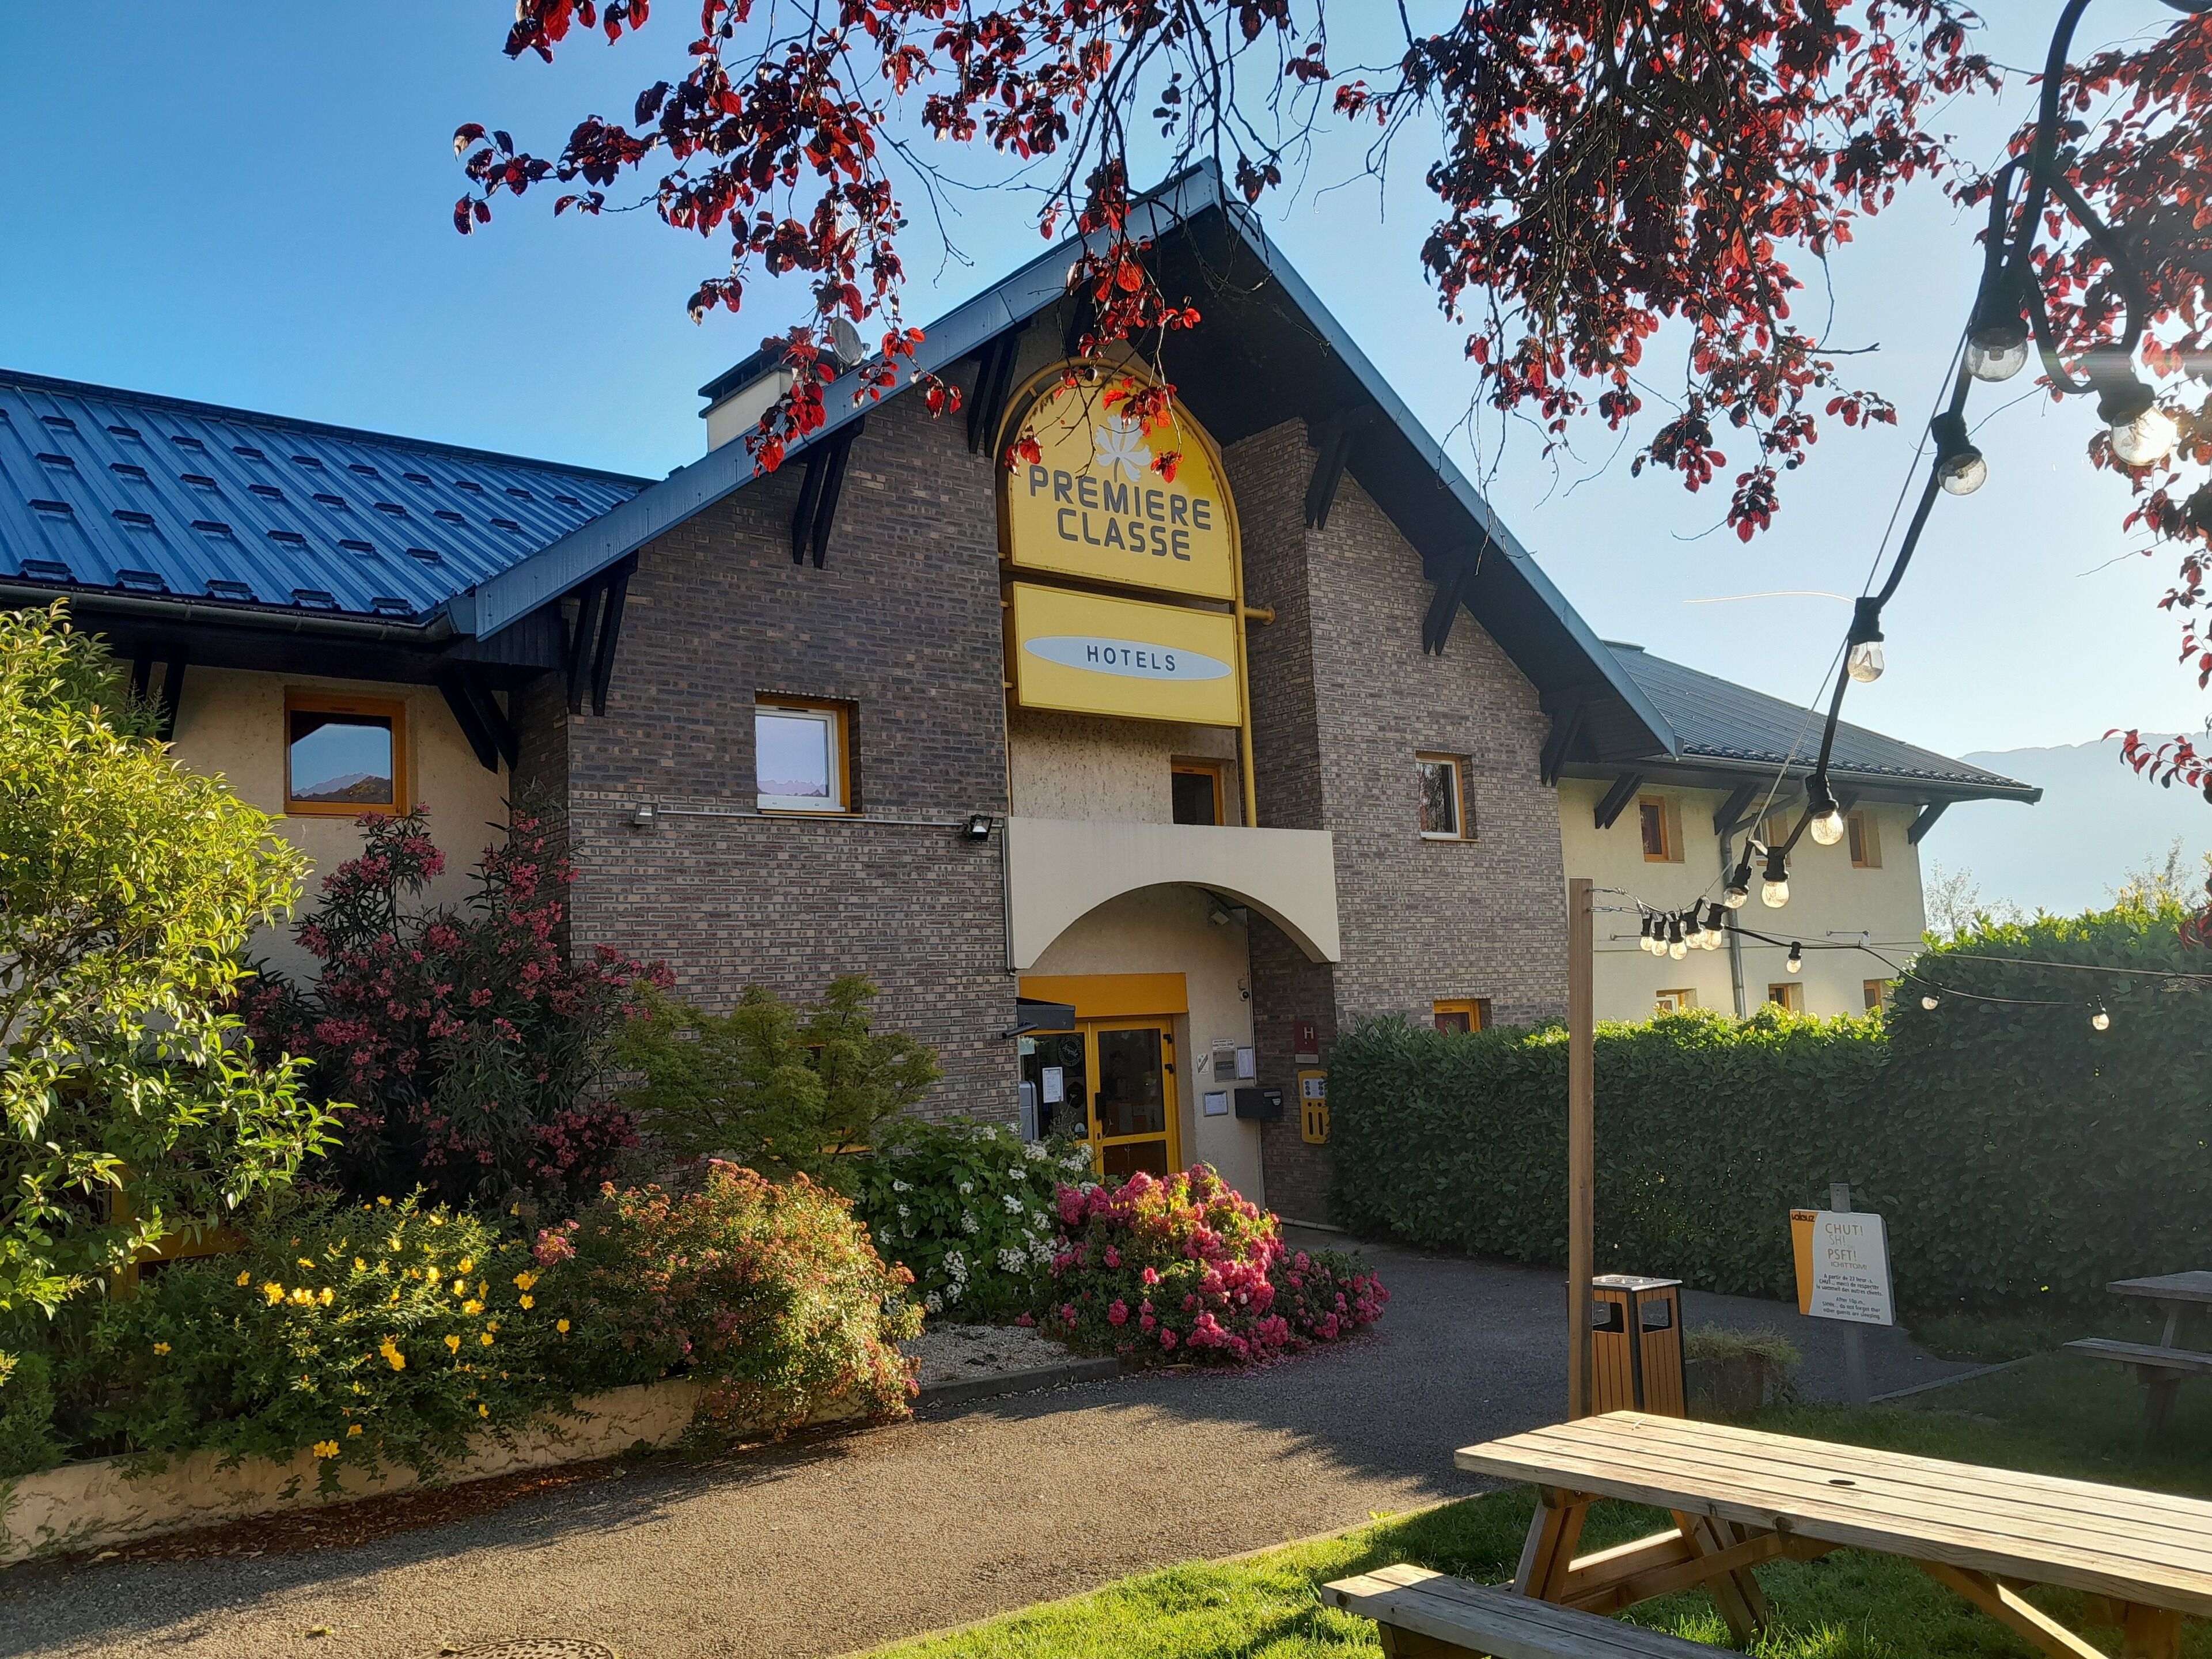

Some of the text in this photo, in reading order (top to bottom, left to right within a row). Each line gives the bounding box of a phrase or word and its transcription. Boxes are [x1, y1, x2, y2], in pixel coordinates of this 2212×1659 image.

[1029, 464, 1211, 531] PREMIERE
[1057, 507, 1191, 561] CLASSE
[1086, 645, 1176, 672] HOTELS
[1304, 1027, 1314, 1039] H
[1825, 1223, 1863, 1236] CHUT!
[1829, 1234, 1846, 1246] SH!
